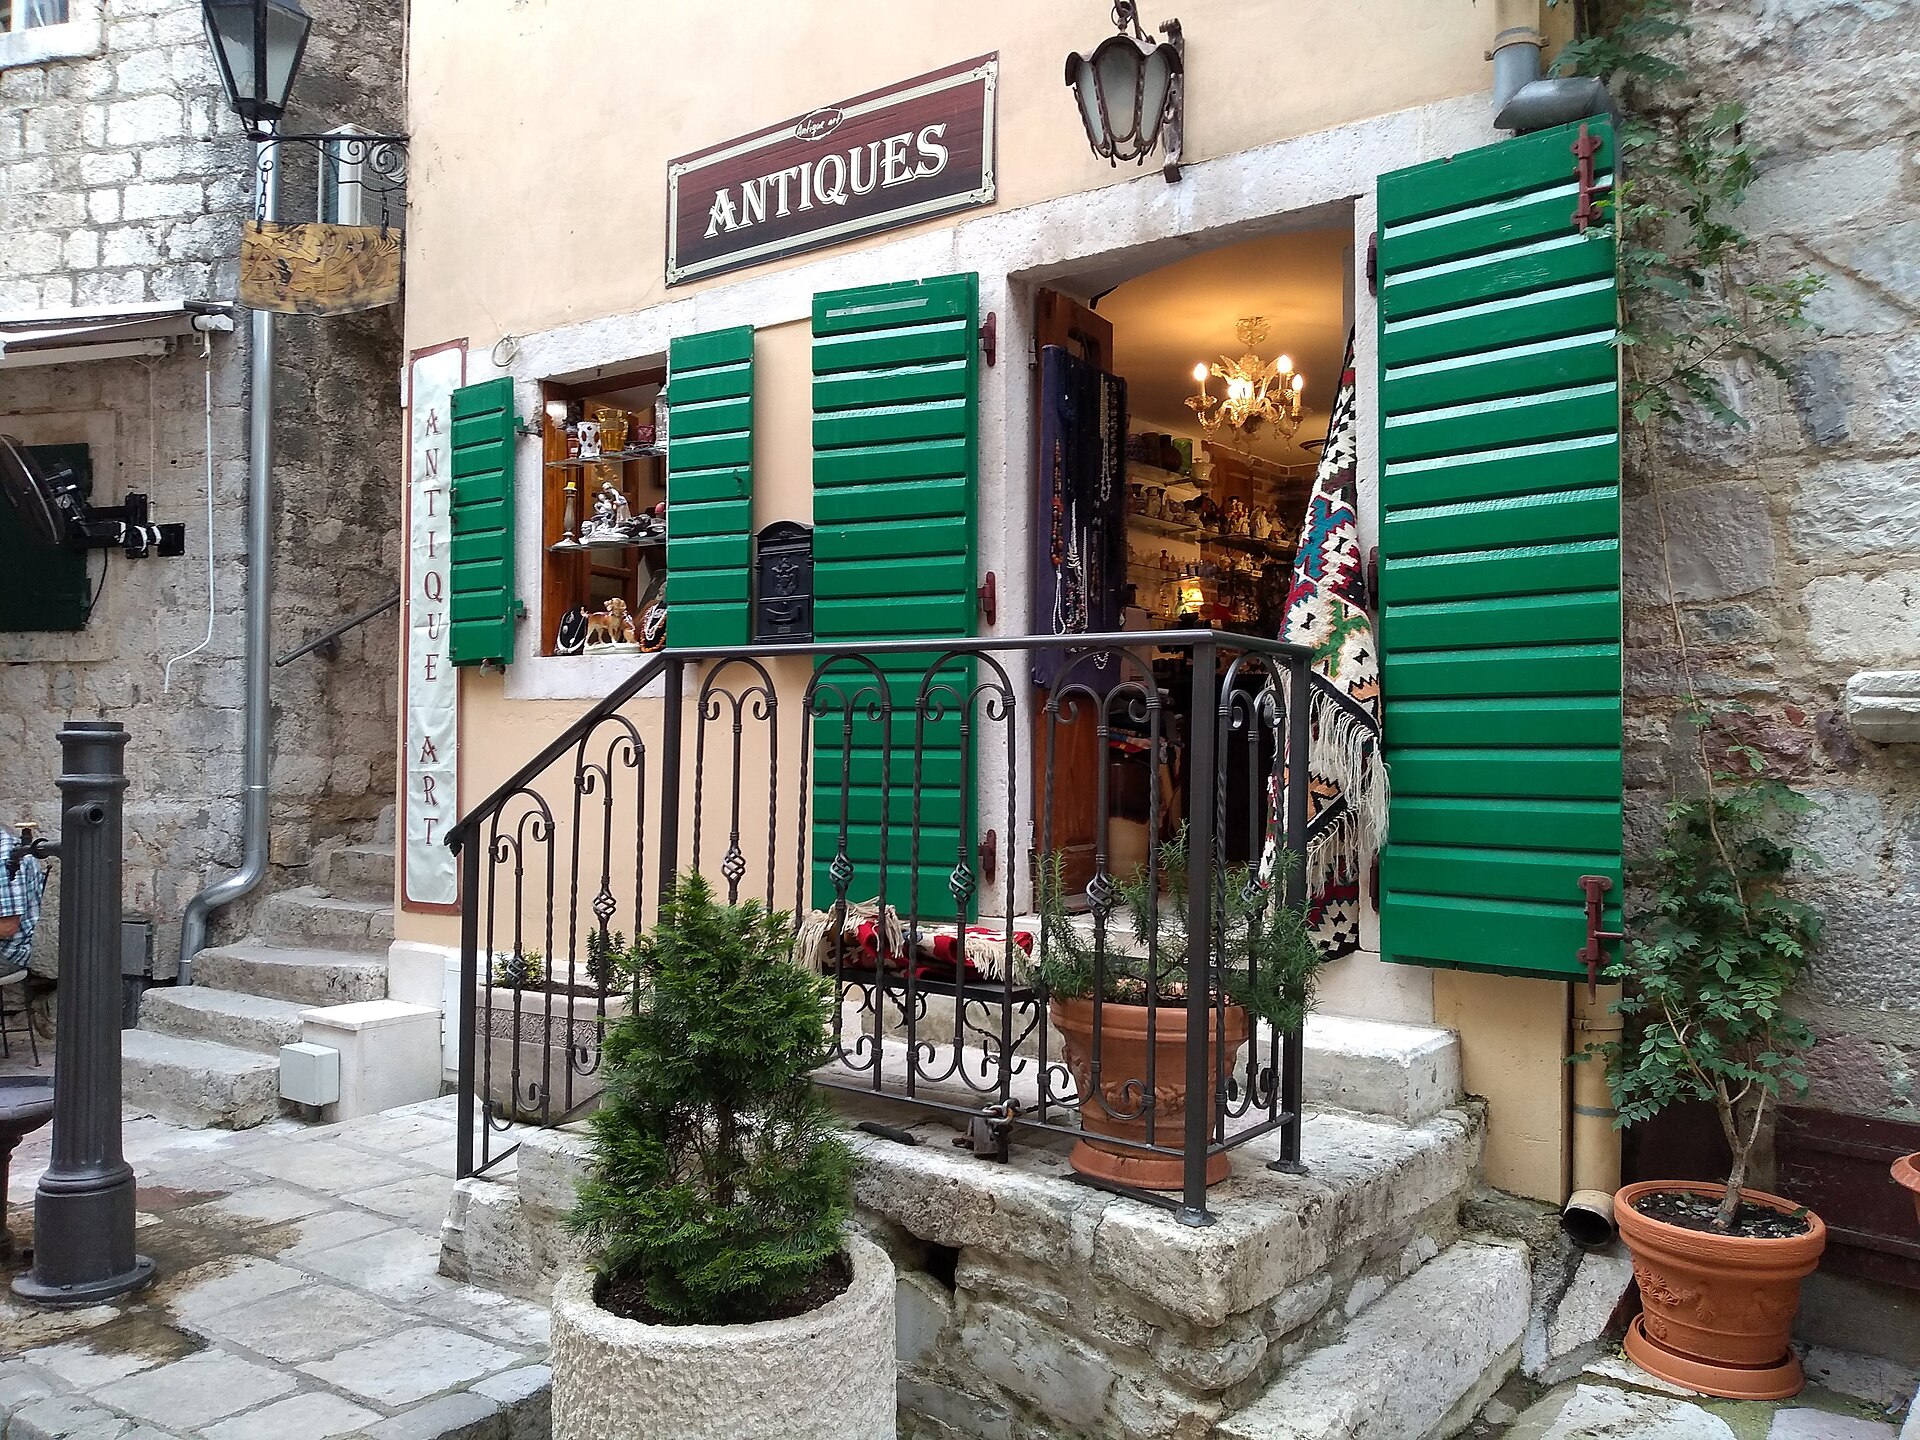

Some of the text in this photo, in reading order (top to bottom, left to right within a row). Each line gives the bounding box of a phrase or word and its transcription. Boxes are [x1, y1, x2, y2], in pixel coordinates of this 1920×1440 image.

[703, 123, 948, 239] ANTIQUES
[419, 408, 443, 845] ANTIQUE ART
